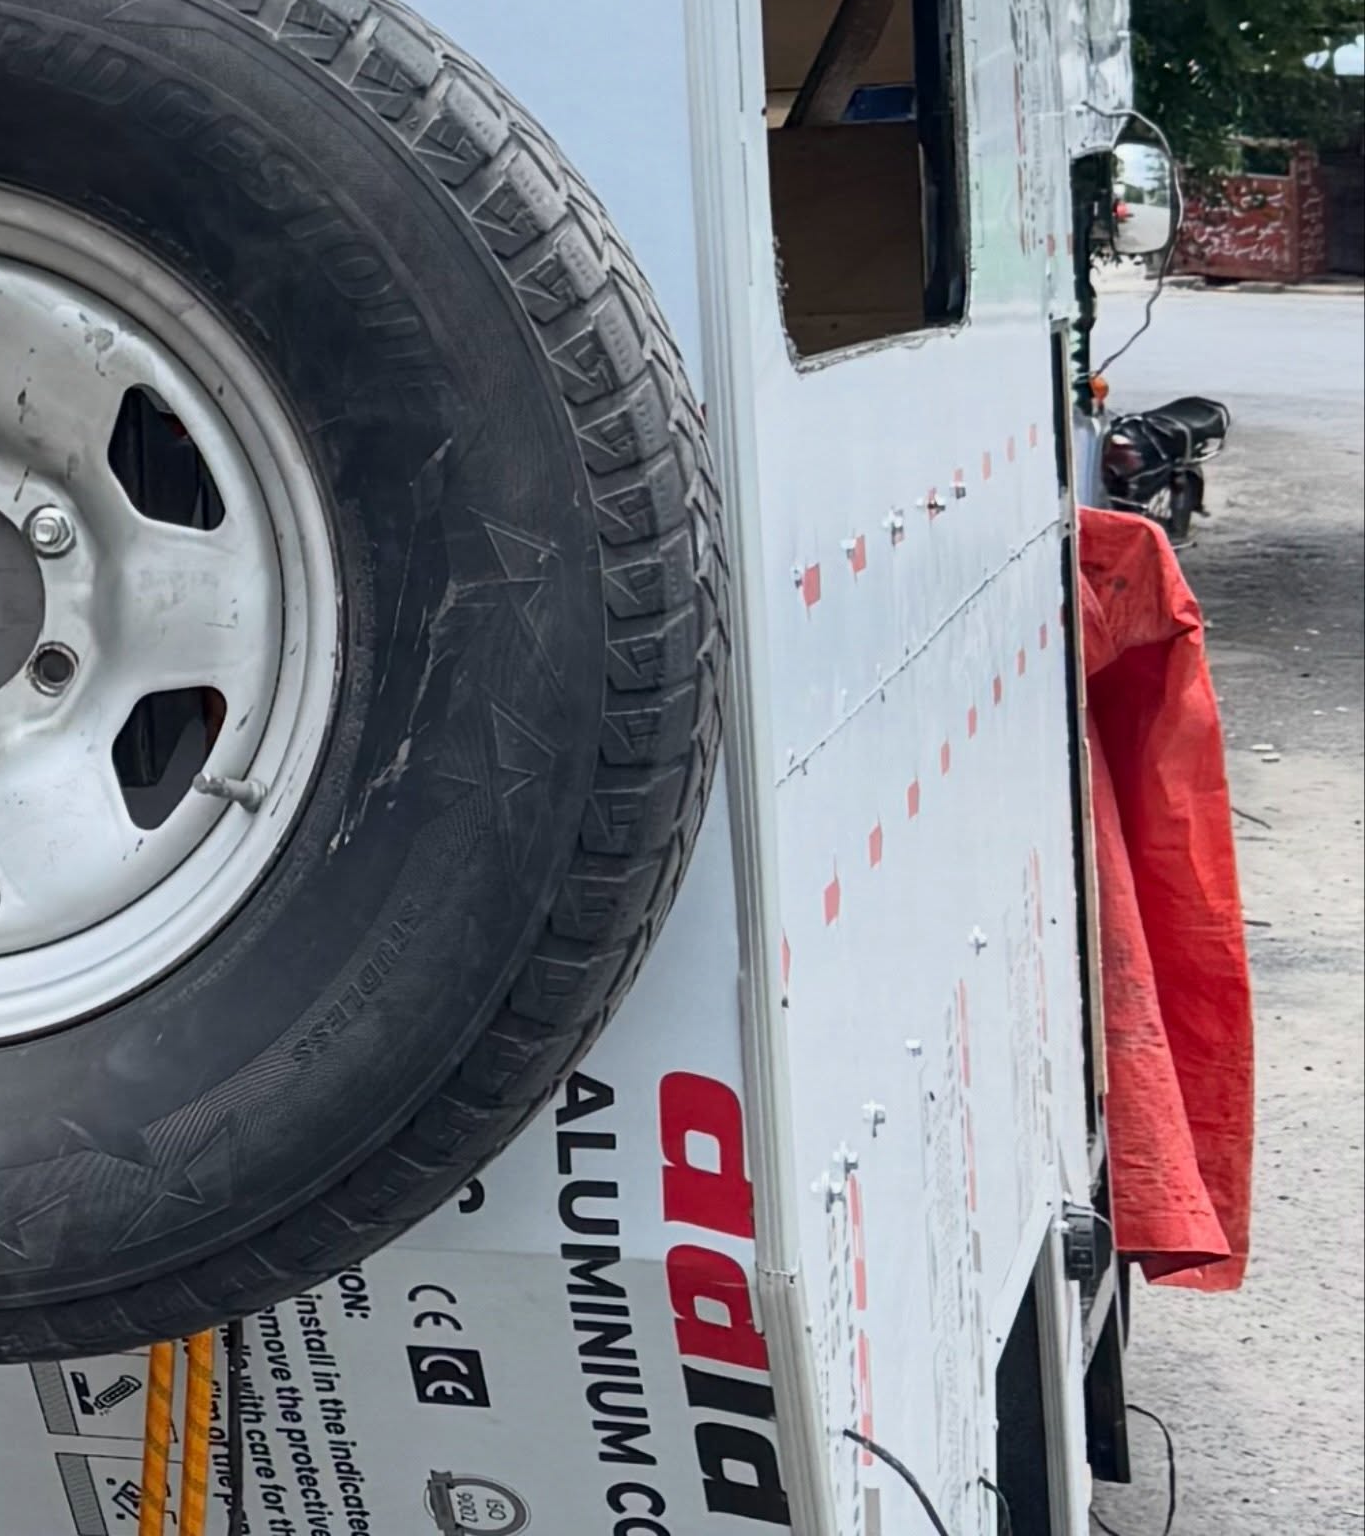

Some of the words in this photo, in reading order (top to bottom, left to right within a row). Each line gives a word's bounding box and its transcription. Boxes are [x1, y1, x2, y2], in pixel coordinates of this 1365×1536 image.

[555, 1070, 658, 1466] ALUMINIUM
[295, 1293, 336, 1369] install
[408, 1284, 463, 1332] CE
[258, 1305, 291, 1381] move
[314, 1372, 341, 1393] in
[420, 1354, 474, 1401] CE
[276, 1384, 304, 1424] the
[319, 1396, 346, 1435] the
[245, 1429, 276, 1479] care
[259, 1484, 287, 1514] for
[275, 1428, 334, 1536] protective
[328, 1440, 370, 1536] indicate
[485, 1498, 508, 1522] ISO
